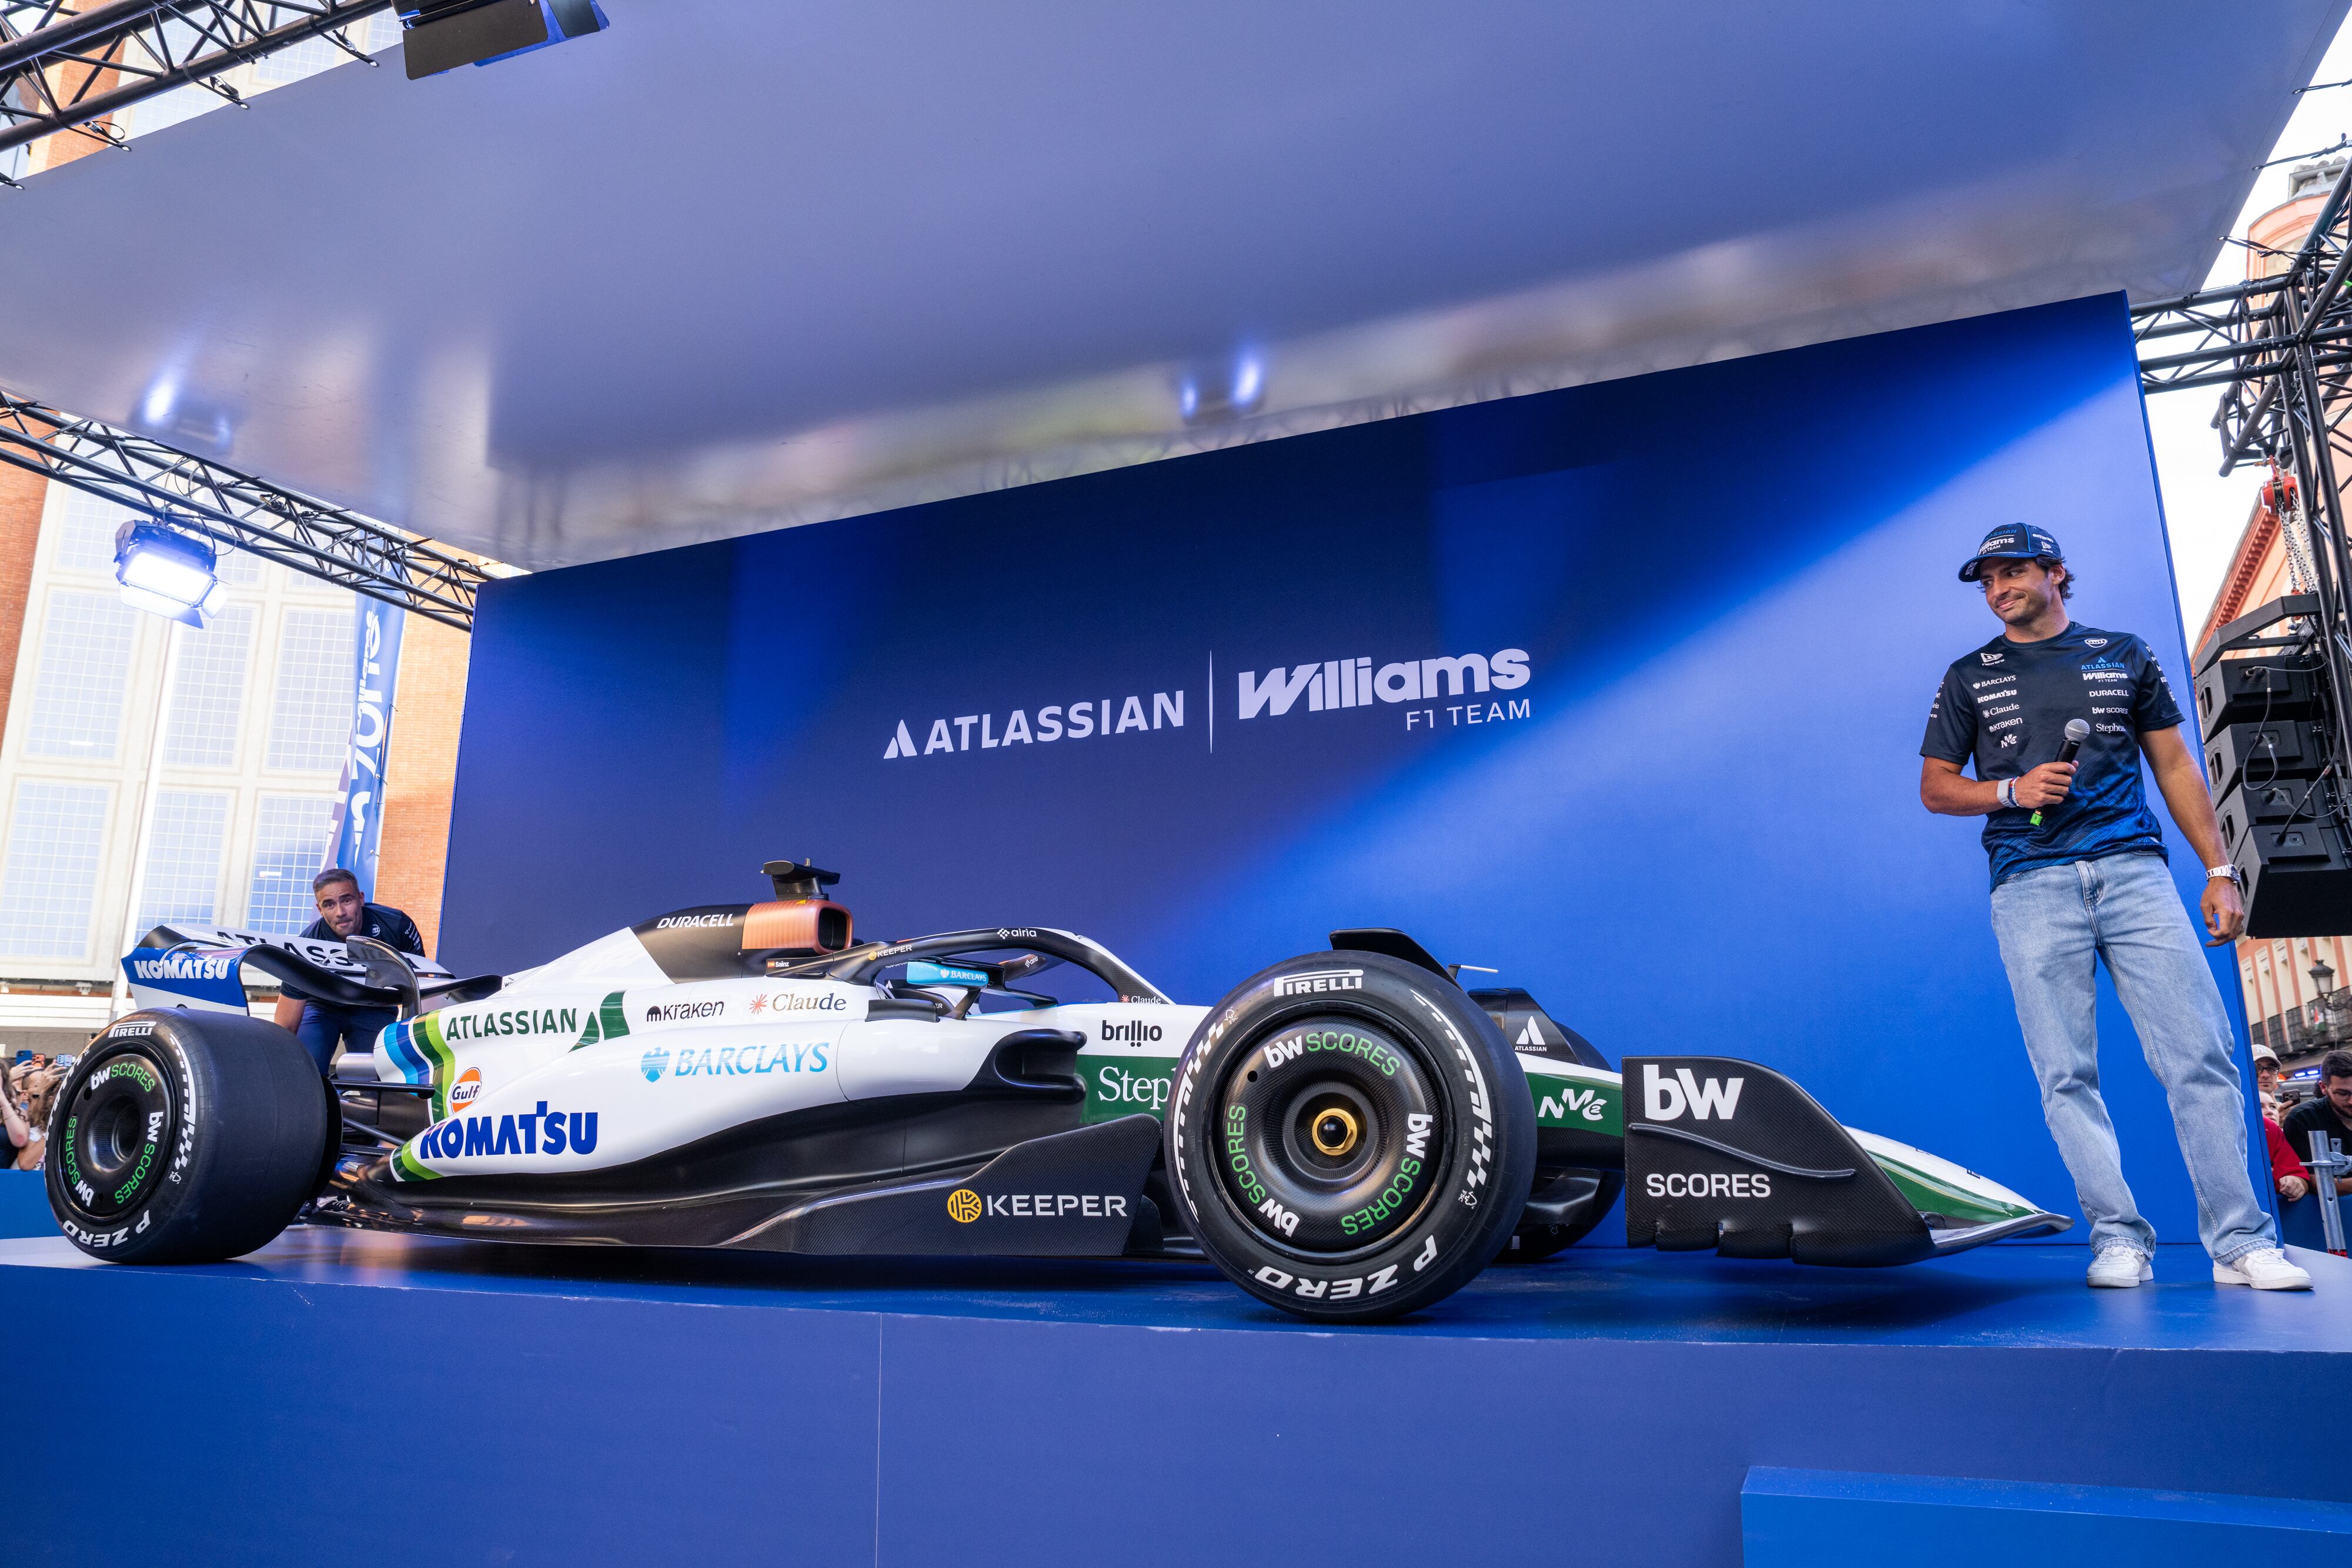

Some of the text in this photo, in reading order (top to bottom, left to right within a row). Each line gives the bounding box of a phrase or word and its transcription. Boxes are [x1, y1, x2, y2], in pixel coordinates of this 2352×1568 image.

[1238, 648, 1531, 720] Williams
[1982, 676, 2016, 687] BARCLAYS
[2083, 673, 2128, 681] Williams
[1977, 689, 2017, 703] KOMATSU
[924, 690, 1185, 755] ATLASSIAN
[1406, 698, 1531, 731] F1 TEAM
[1990, 704, 2020, 716] Claude
[1993, 717, 2023, 731] kraken
[657, 914, 734, 930] DURACELL
[1011, 928, 1037, 937] airia
[877, 945, 913, 958] KEEPER
[1030, 955, 1039, 965] airia
[134, 955, 230, 979] KOMATSU
[950, 970, 987, 982] BARCLAYS
[1274, 969, 1364, 996] PIRELLI
[663, 1000, 724, 1021] kraken
[772, 994, 847, 1013] Claude
[1131, 995, 1161, 1004] Claude
[108, 1021, 157, 1038] PIRELLI
[446, 1007, 577, 1041] ATLASSIAN
[1102, 1020, 1162, 1048] brillio
[674, 1042, 830, 1077] BARCLAYS
[1264, 1031, 1401, 1076] bw SCORES
[90, 1062, 155, 1092] bw SCORES
[1098, 1066, 1173, 1110] Step
[452, 1085, 480, 1104] Gulf
[1643, 1064, 1744, 1120] bw
[420, 1101, 598, 1159] KOMATSU
[65, 1117, 95, 1207] bw SCORES
[114, 1111, 163, 1204] bw SCORES
[1228, 1105, 1300, 1238] bw SCORES
[1341, 1113, 1433, 1235] bw SCORES
[1458, 1189, 1467, 1202] FSC
[1646, 1174, 1771, 1198] SCORES
[987, 1195, 1127, 1216] KEEPER
[62, 1210, 151, 1248] P ZERO
[1414, 1235, 1438, 1272] P
[1254, 1263, 1398, 1300] ZERO
